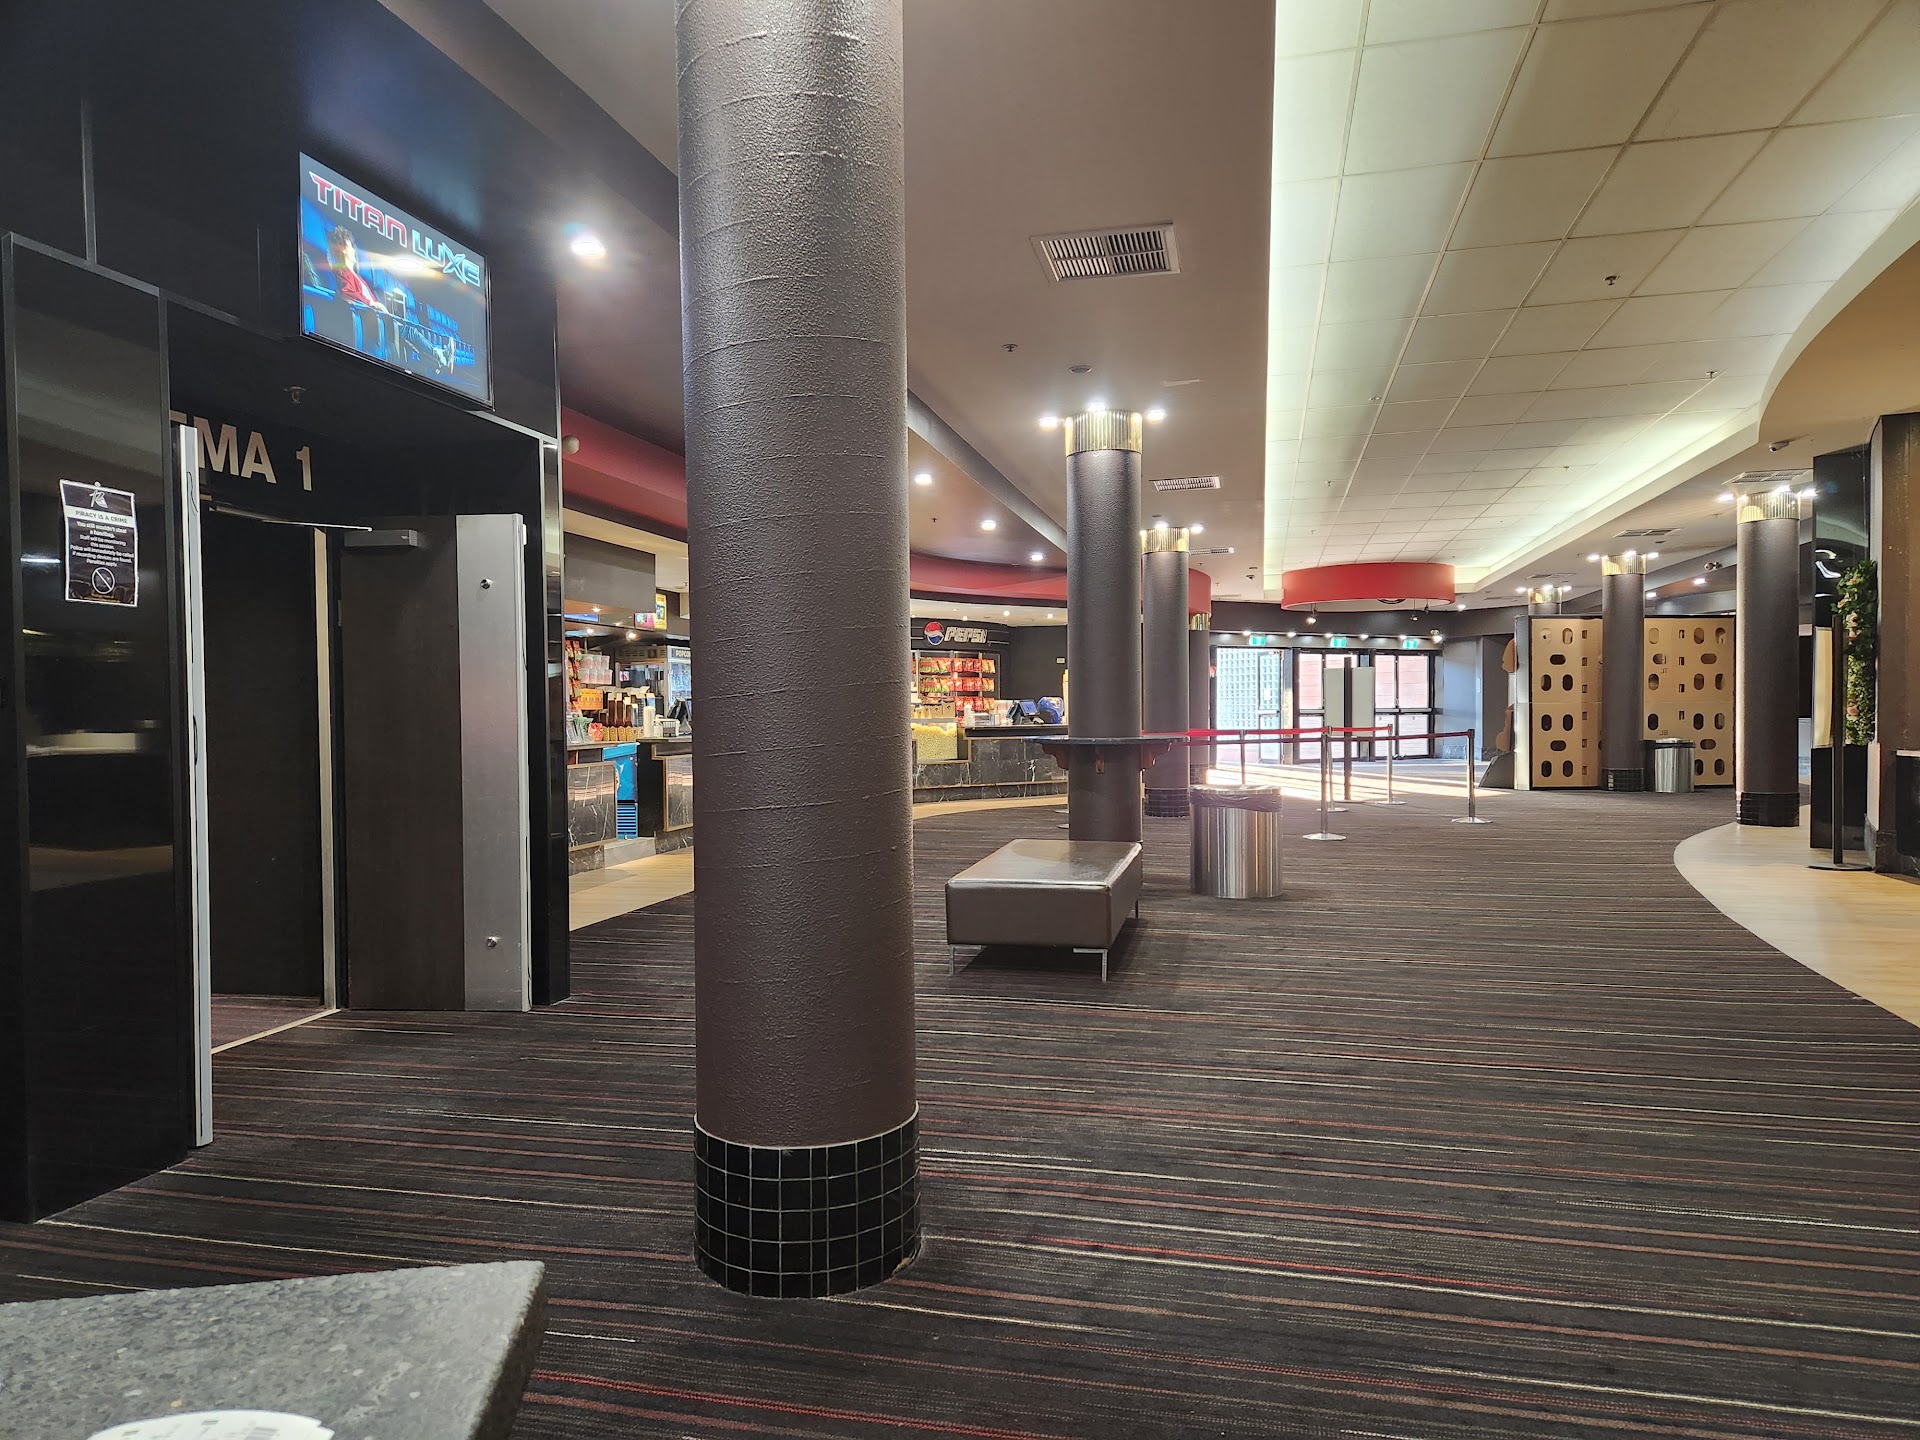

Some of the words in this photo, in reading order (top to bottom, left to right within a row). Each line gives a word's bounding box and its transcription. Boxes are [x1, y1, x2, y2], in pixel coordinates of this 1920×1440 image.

[309, 171, 407, 248] TITAN
[412, 229, 480, 287] LUXE
[170, 410, 277, 484] MA
[296, 446, 312, 491] 1
[944, 626, 988, 643] PEPSI
